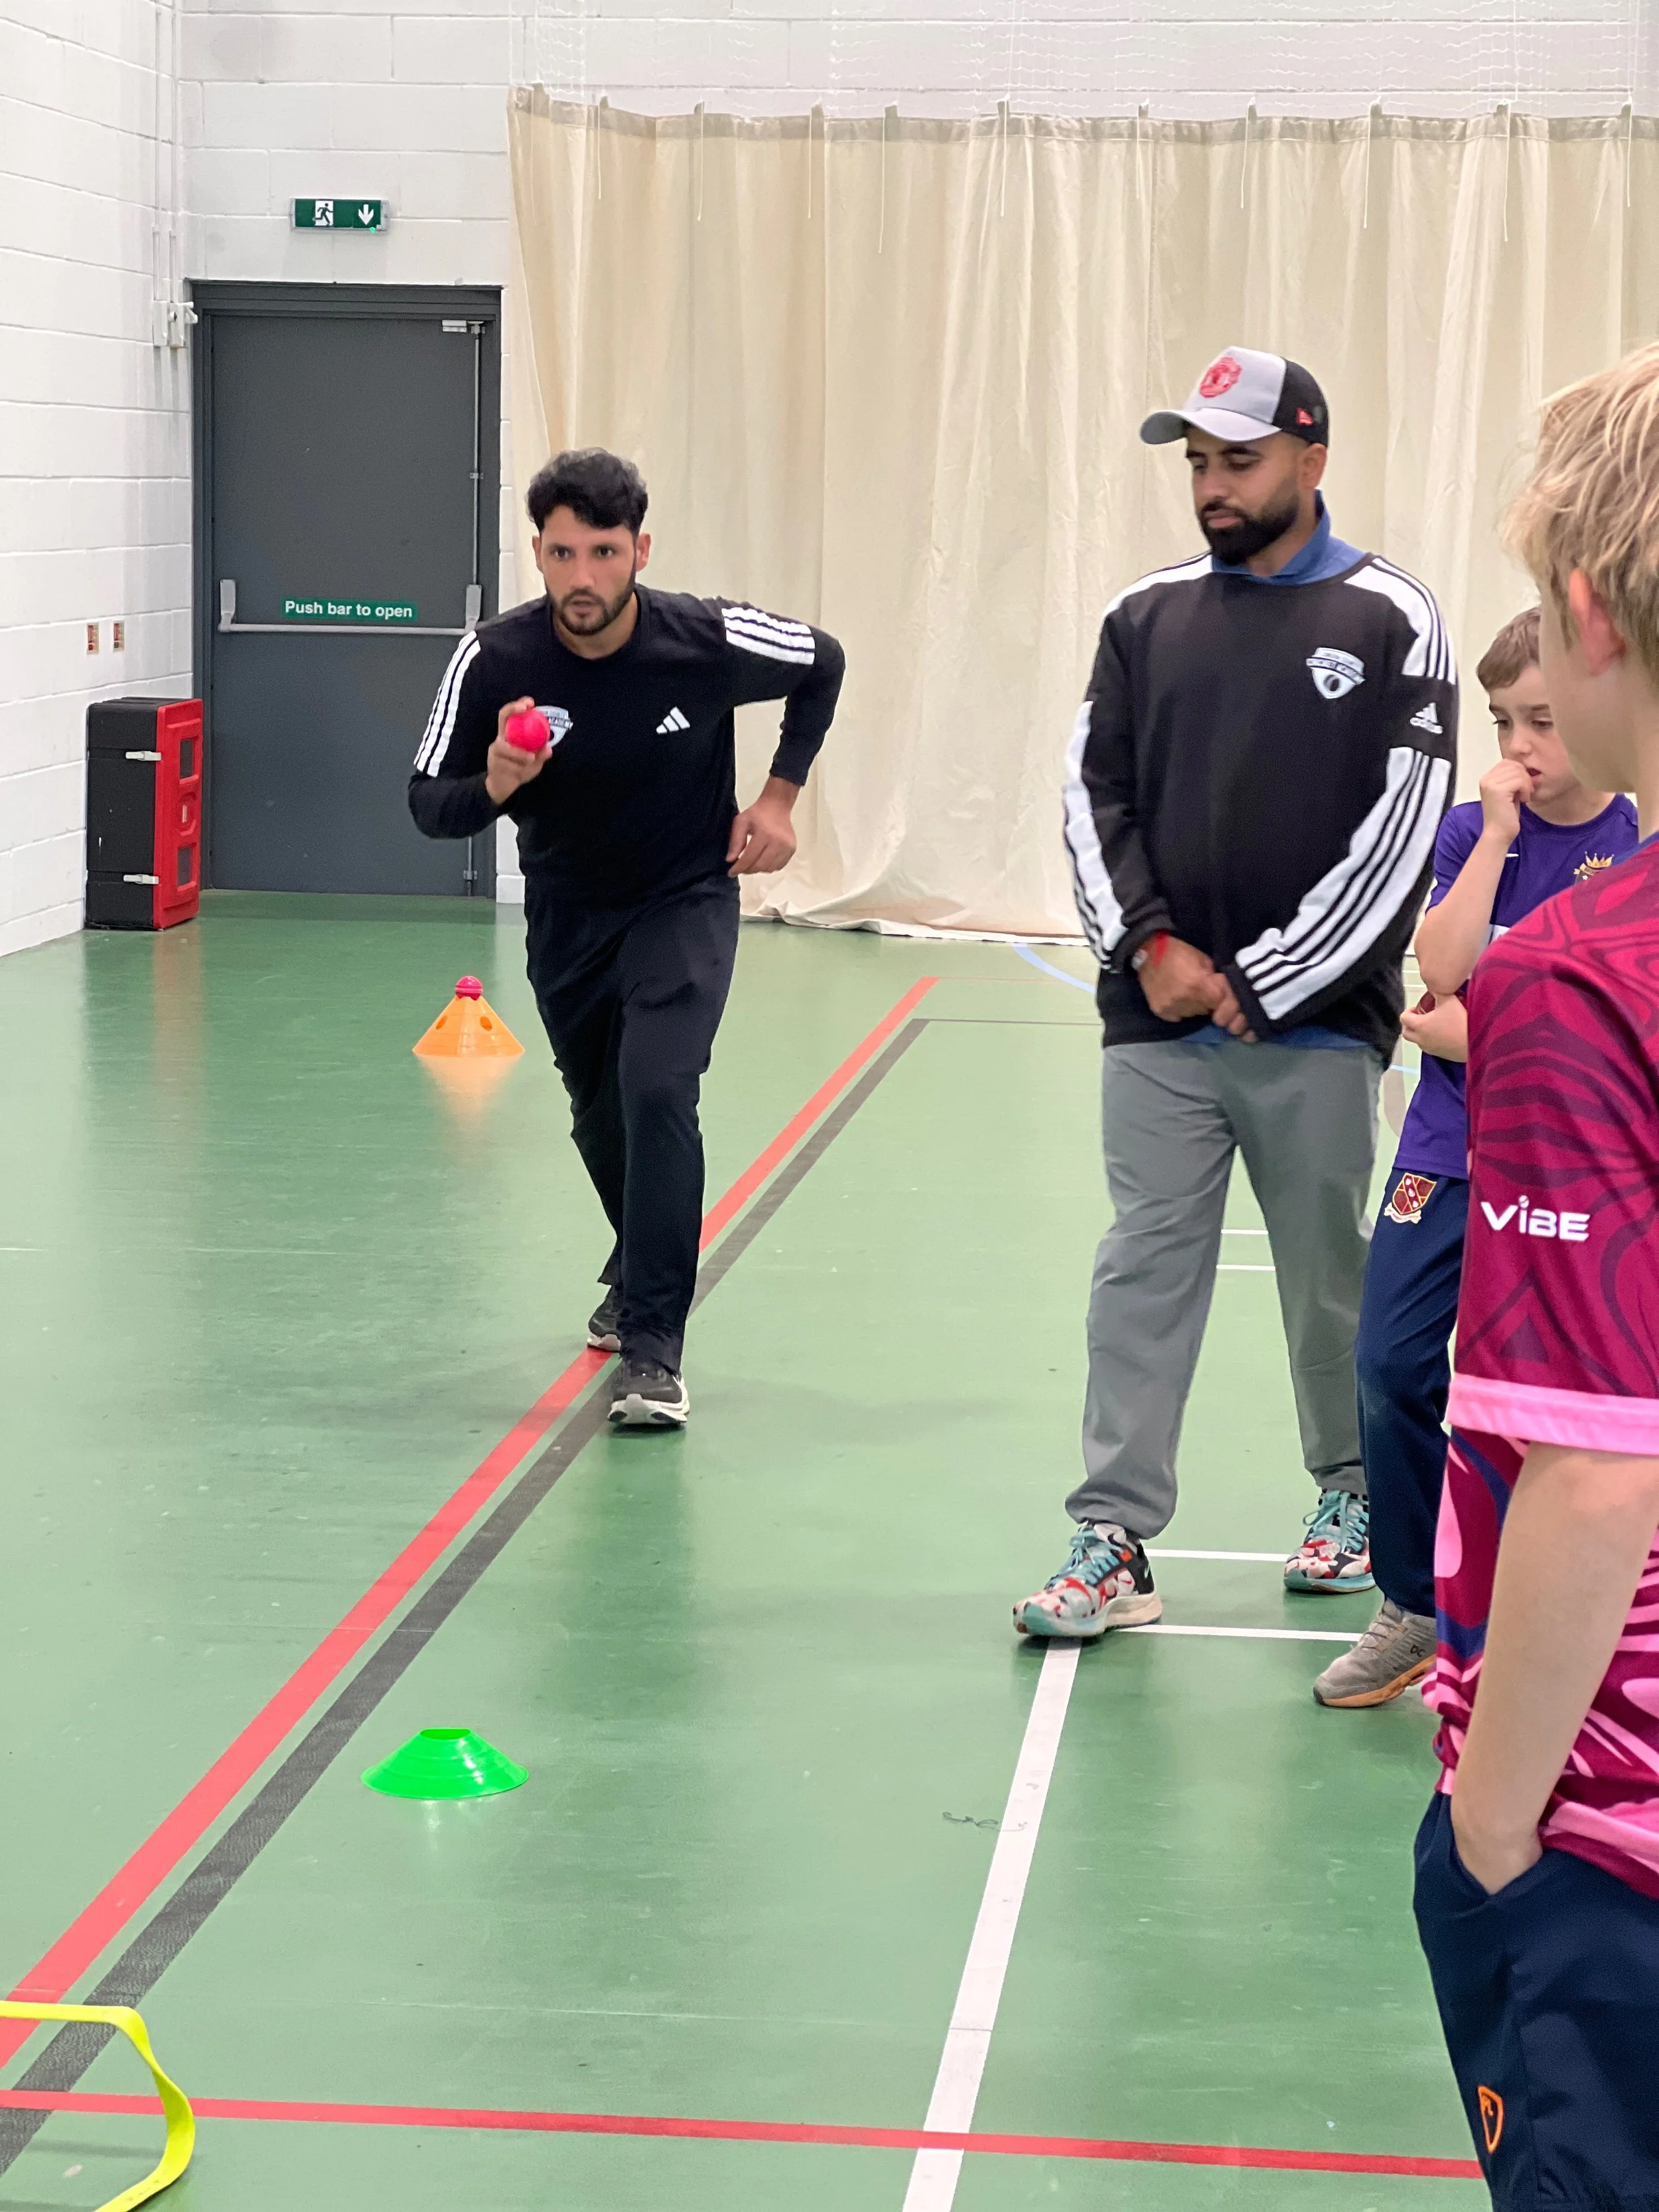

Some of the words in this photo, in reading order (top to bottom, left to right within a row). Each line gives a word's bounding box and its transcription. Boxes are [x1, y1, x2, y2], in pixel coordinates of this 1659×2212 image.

[285, 601, 323, 614] Push
[327, 602, 352, 615] bar
[356, 604, 371, 616] to
[375, 607, 413, 620] open
